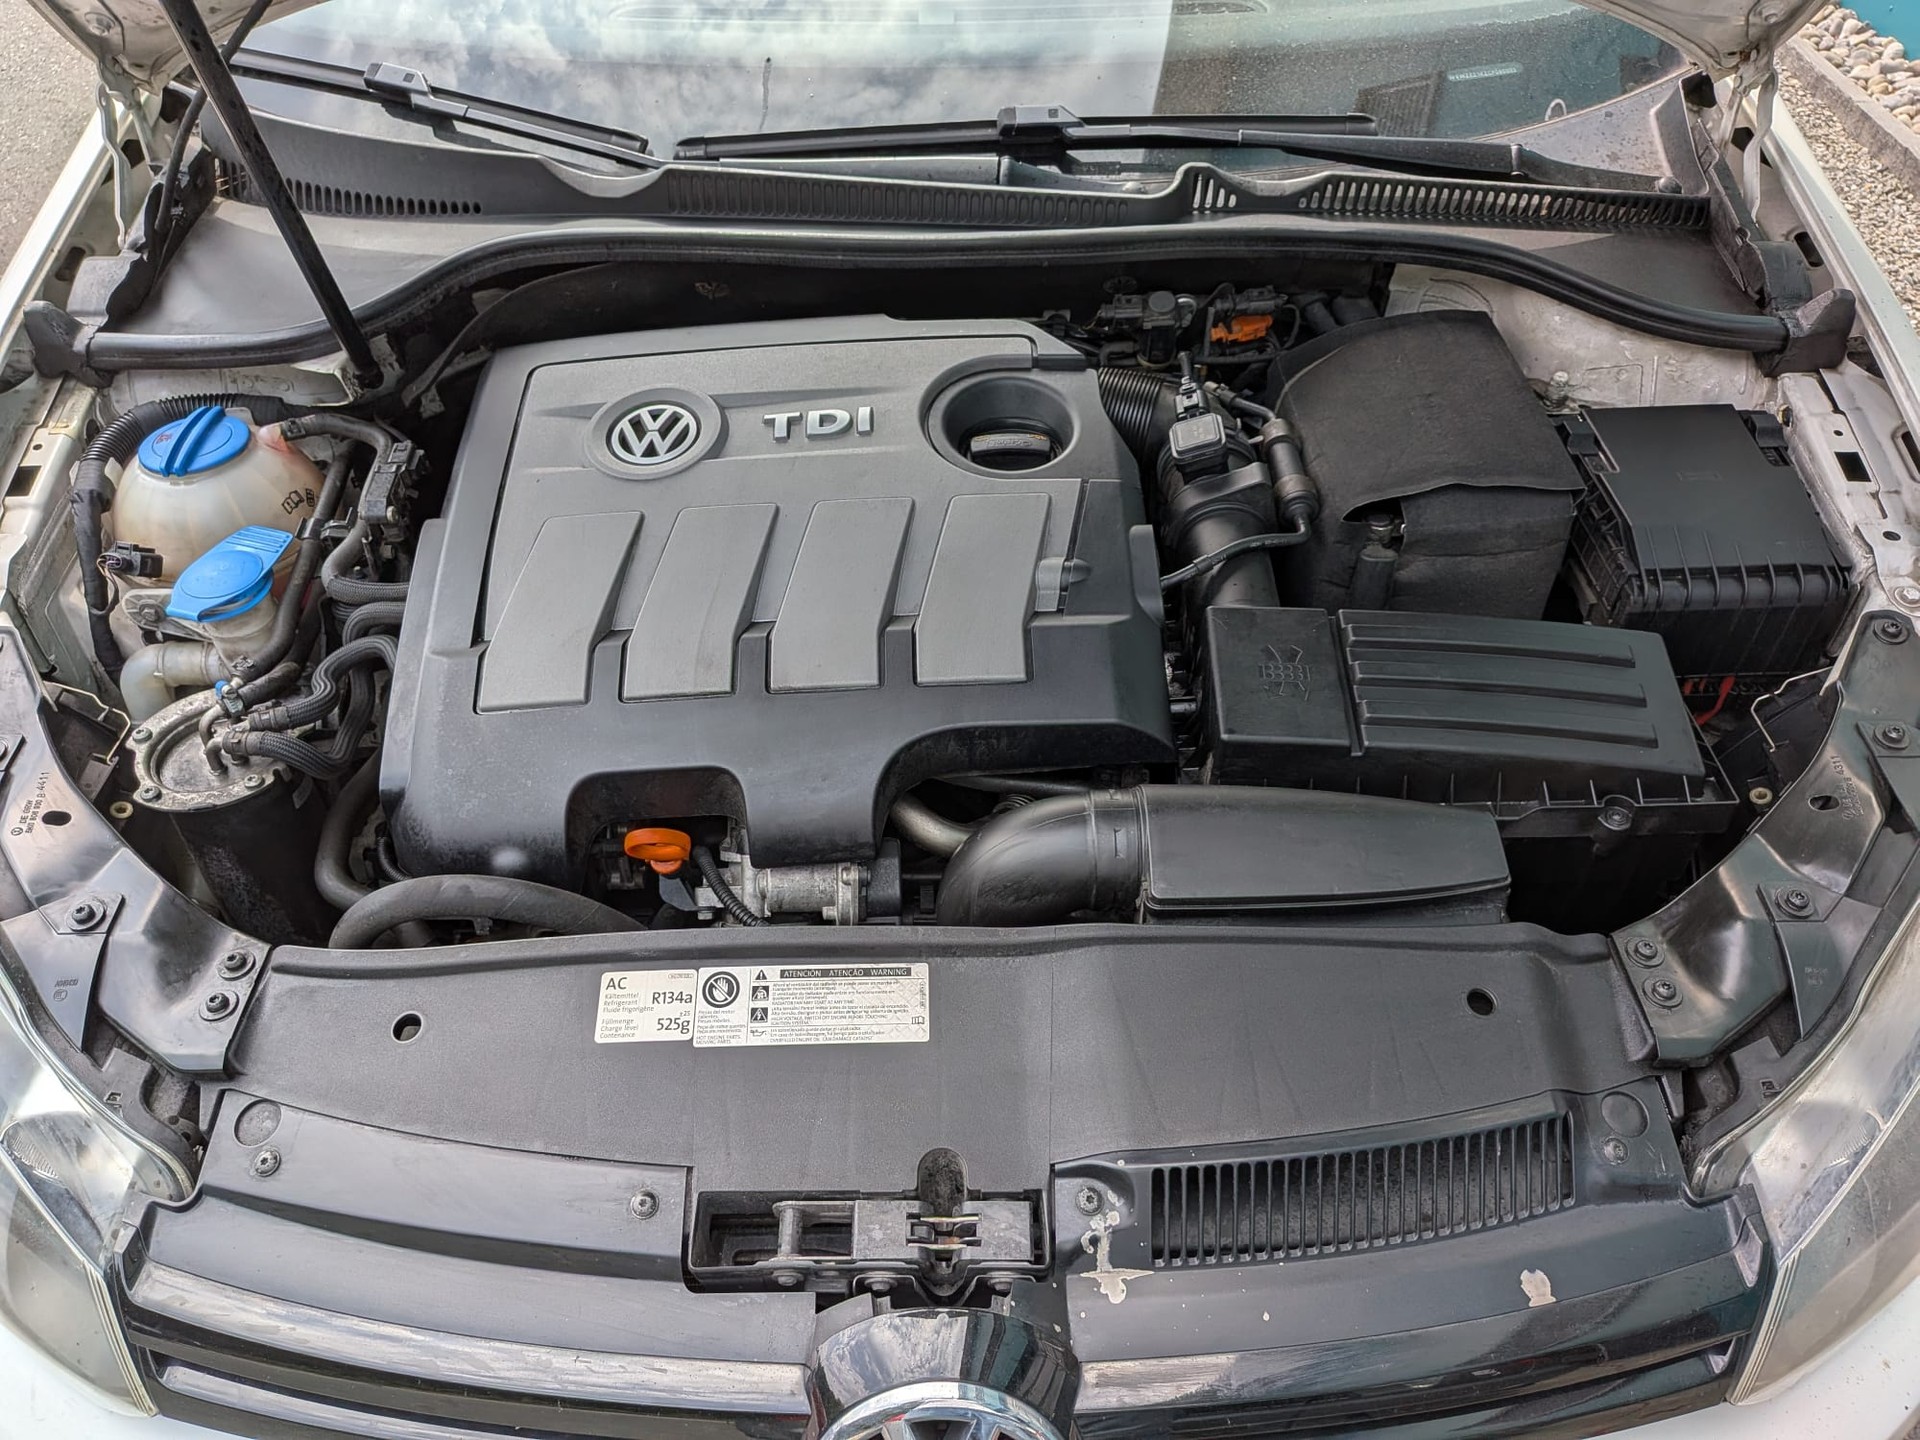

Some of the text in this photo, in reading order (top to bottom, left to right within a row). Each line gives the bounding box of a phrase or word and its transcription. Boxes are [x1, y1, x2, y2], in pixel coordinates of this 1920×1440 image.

[763, 406, 874, 442] TDI
[612, 405, 695, 463] VW
[870, 968, 907, 976] WARNING
[606, 977, 627, 990] AC
[605, 992, 639, 1000] Kältemittel
[652, 991, 693, 1005] R134a
[604, 1000, 638, 1008] Refrigerant
[602, 1018, 634, 1027] Füllmenge
[656, 1018, 691, 1035] 525g
[601, 1025, 623, 1033] Charge
